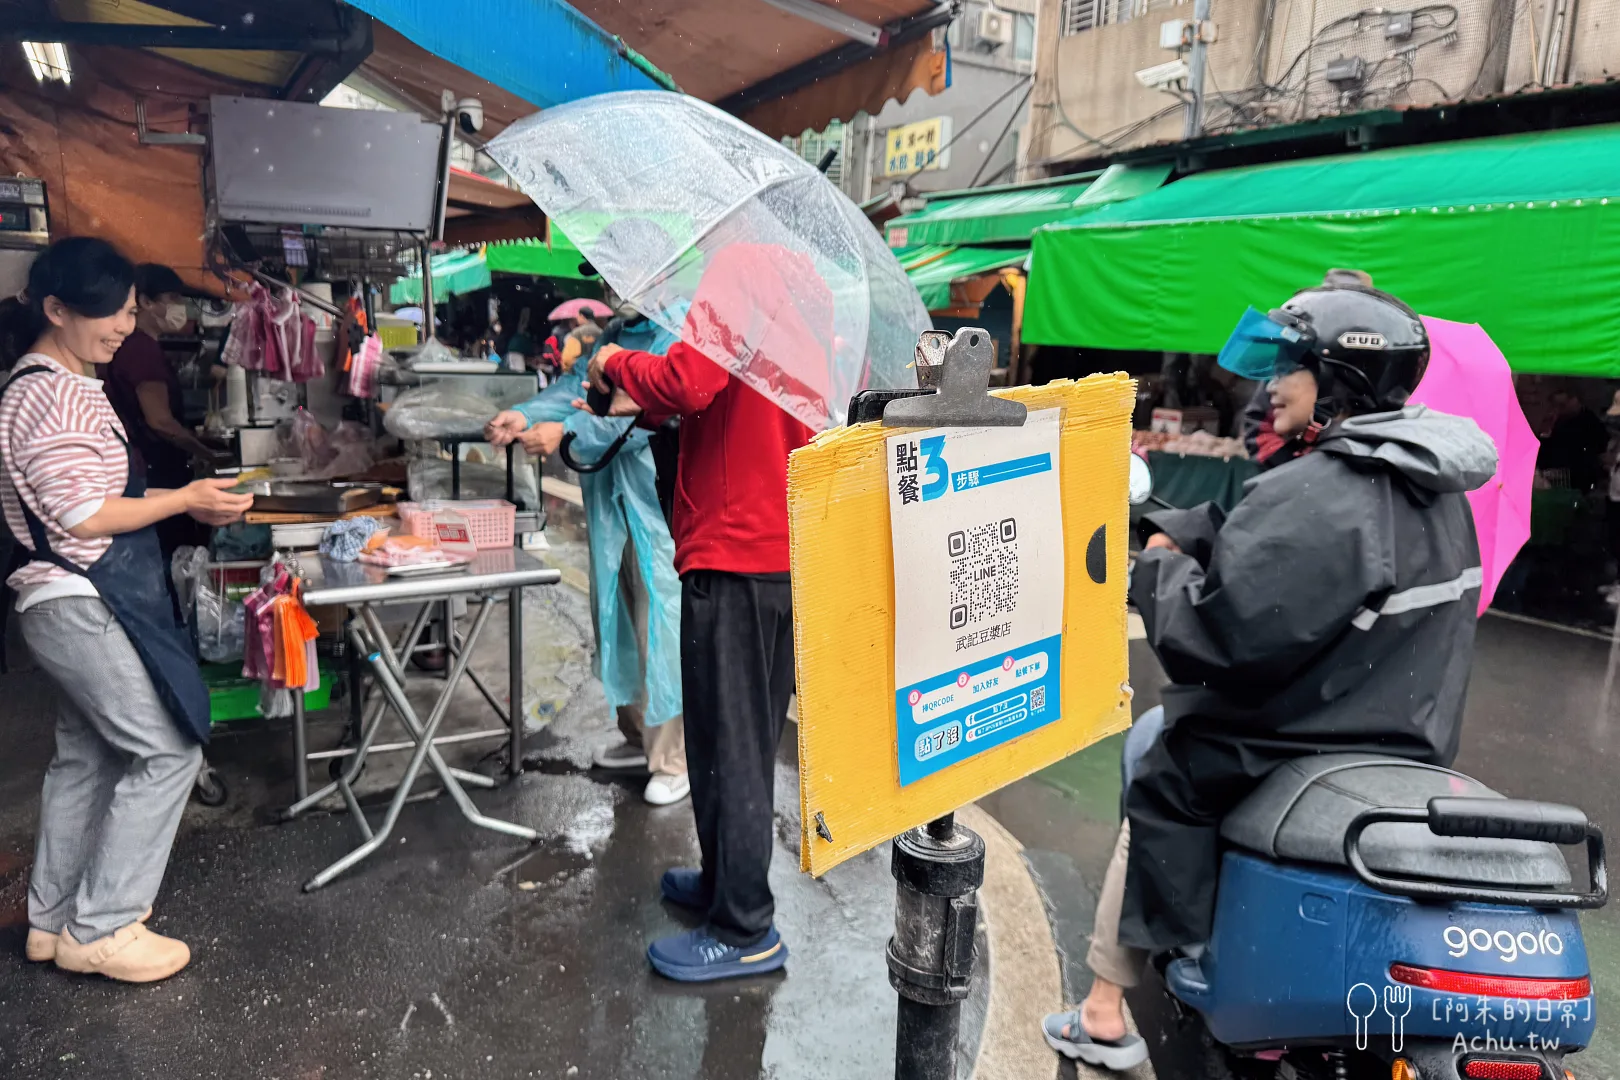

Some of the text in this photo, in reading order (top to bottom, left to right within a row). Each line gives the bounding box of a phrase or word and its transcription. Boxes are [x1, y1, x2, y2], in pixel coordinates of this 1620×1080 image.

[896, 434, 980, 505] 點餐 3 步驟
[973, 566, 996, 582] LINE
[955, 622, 1011, 652] 武記豆漿店
[972, 677, 999, 694] 加入好友
[1443, 926, 1563, 962] gogoro
